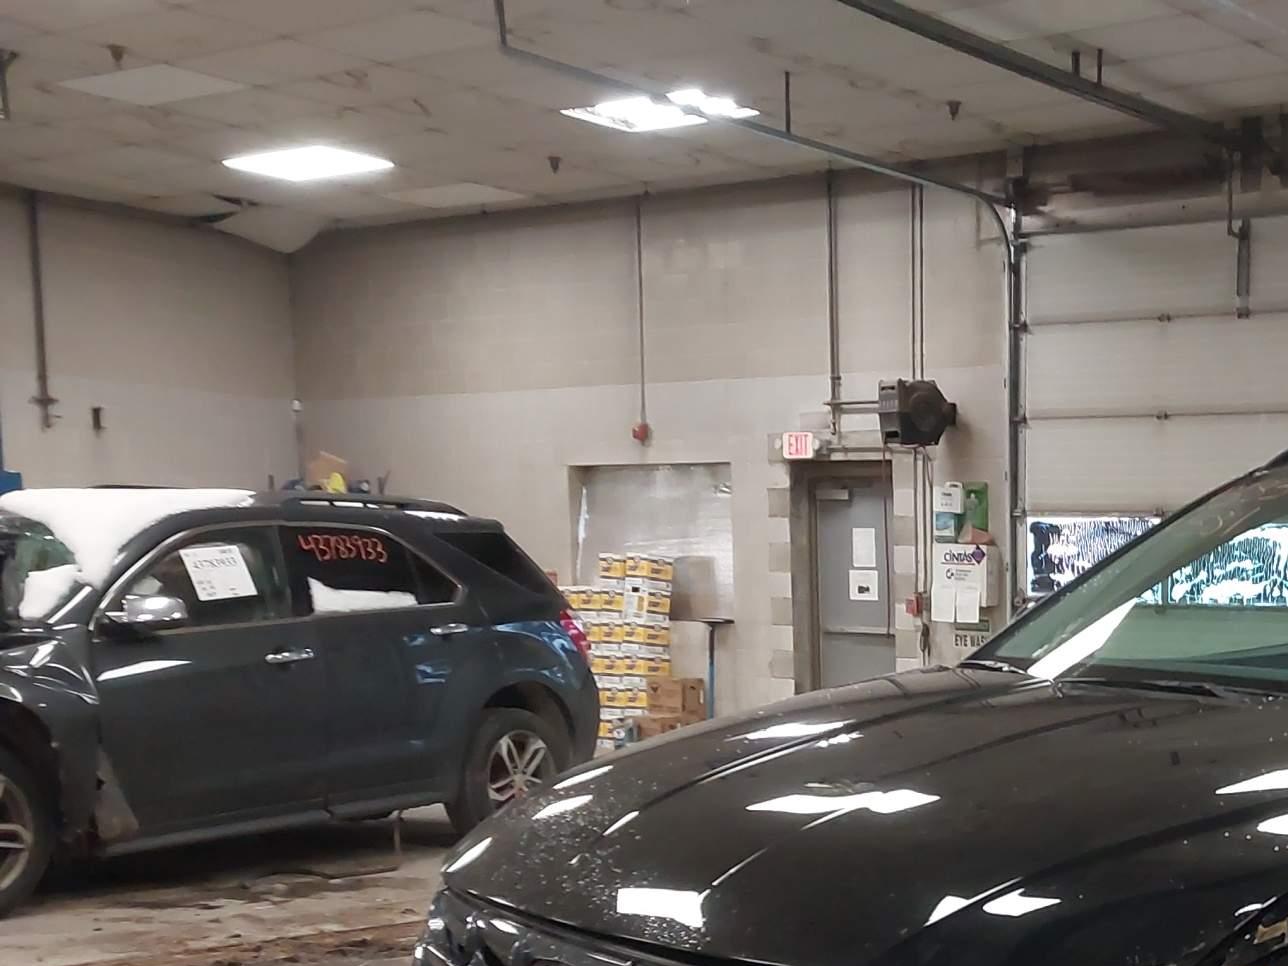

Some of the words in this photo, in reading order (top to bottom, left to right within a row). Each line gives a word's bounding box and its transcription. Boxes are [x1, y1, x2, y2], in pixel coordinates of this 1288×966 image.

[788, 433, 809, 456] EXIT
[298, 534, 388, 564] 43783933
[943, 550, 973, 563] CINTAS
[954, 633, 968, 647] EYE
